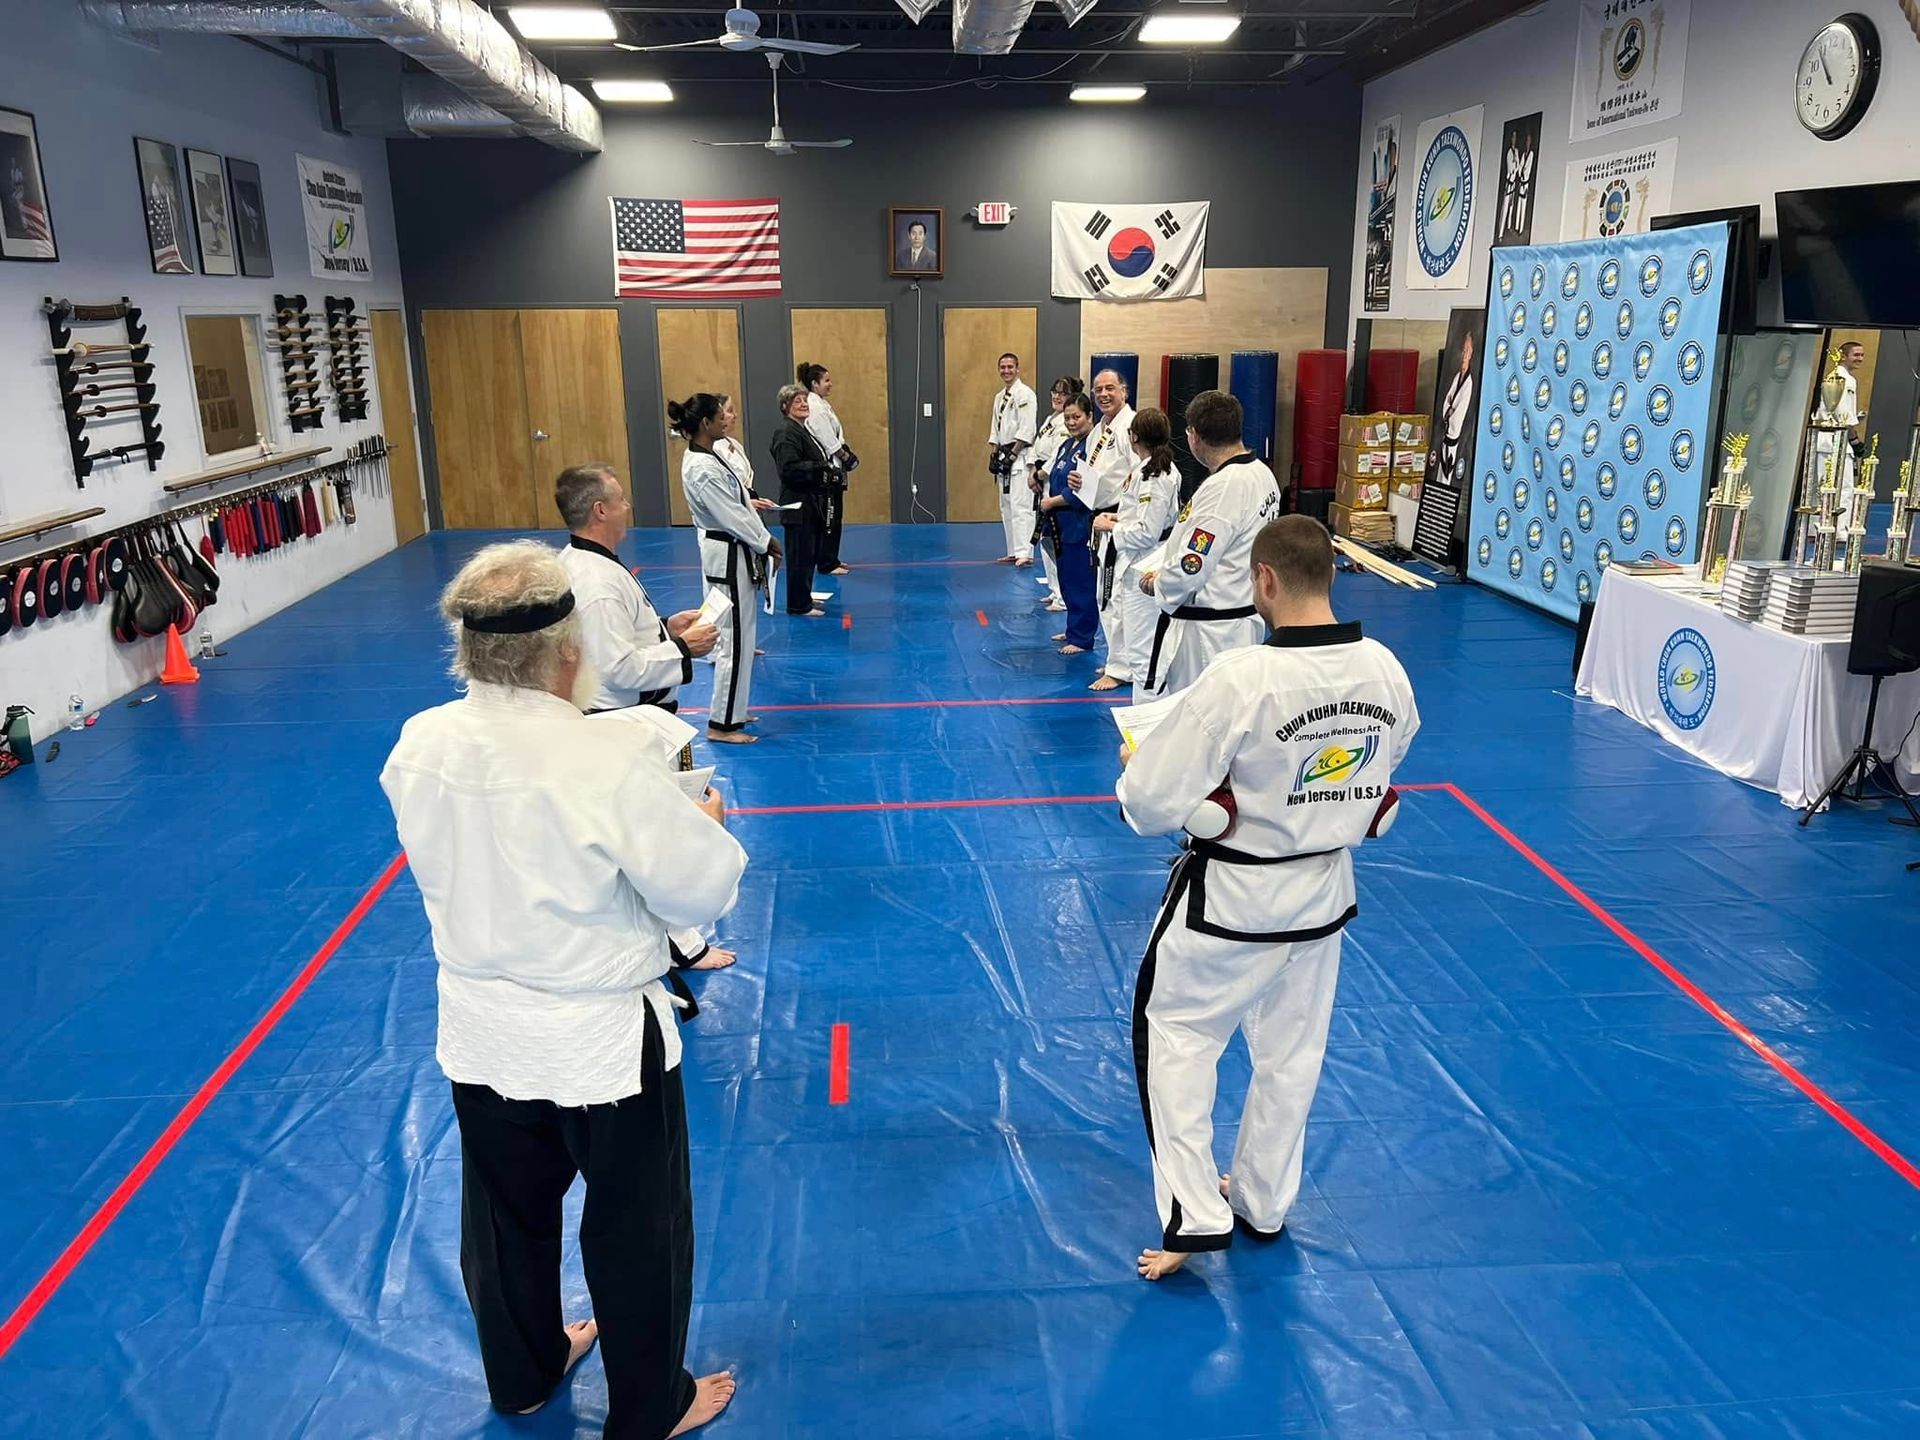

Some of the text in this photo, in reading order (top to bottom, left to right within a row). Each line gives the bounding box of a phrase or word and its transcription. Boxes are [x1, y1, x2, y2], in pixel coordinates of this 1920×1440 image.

[1809, 59, 1820, 73] 10
[1848, 64, 1856, 78] 3
[1804, 76, 1812, 87] 9
[1806, 93, 1813, 106] 8
[1835, 98, 1842, 112] 5
[1814, 103, 1820, 117] 7
[1823, 106, 1830, 119] 6
[984, 203, 1006, 222] EXIT
[1418, 170, 1428, 207] CHUN
[1454, 167, 1471, 251] FEDERATION
[1660, 645, 1672, 669] CHUN
[1659, 670, 1668, 703] WORLD
[1275, 713, 1307, 743] CHUN
[1306, 703, 1338, 723] KUHN
[1294, 725, 1381, 742] Complete Wellness Art
[1287, 793, 1307, 807] New
[1308, 788, 1346, 803] Jersey
